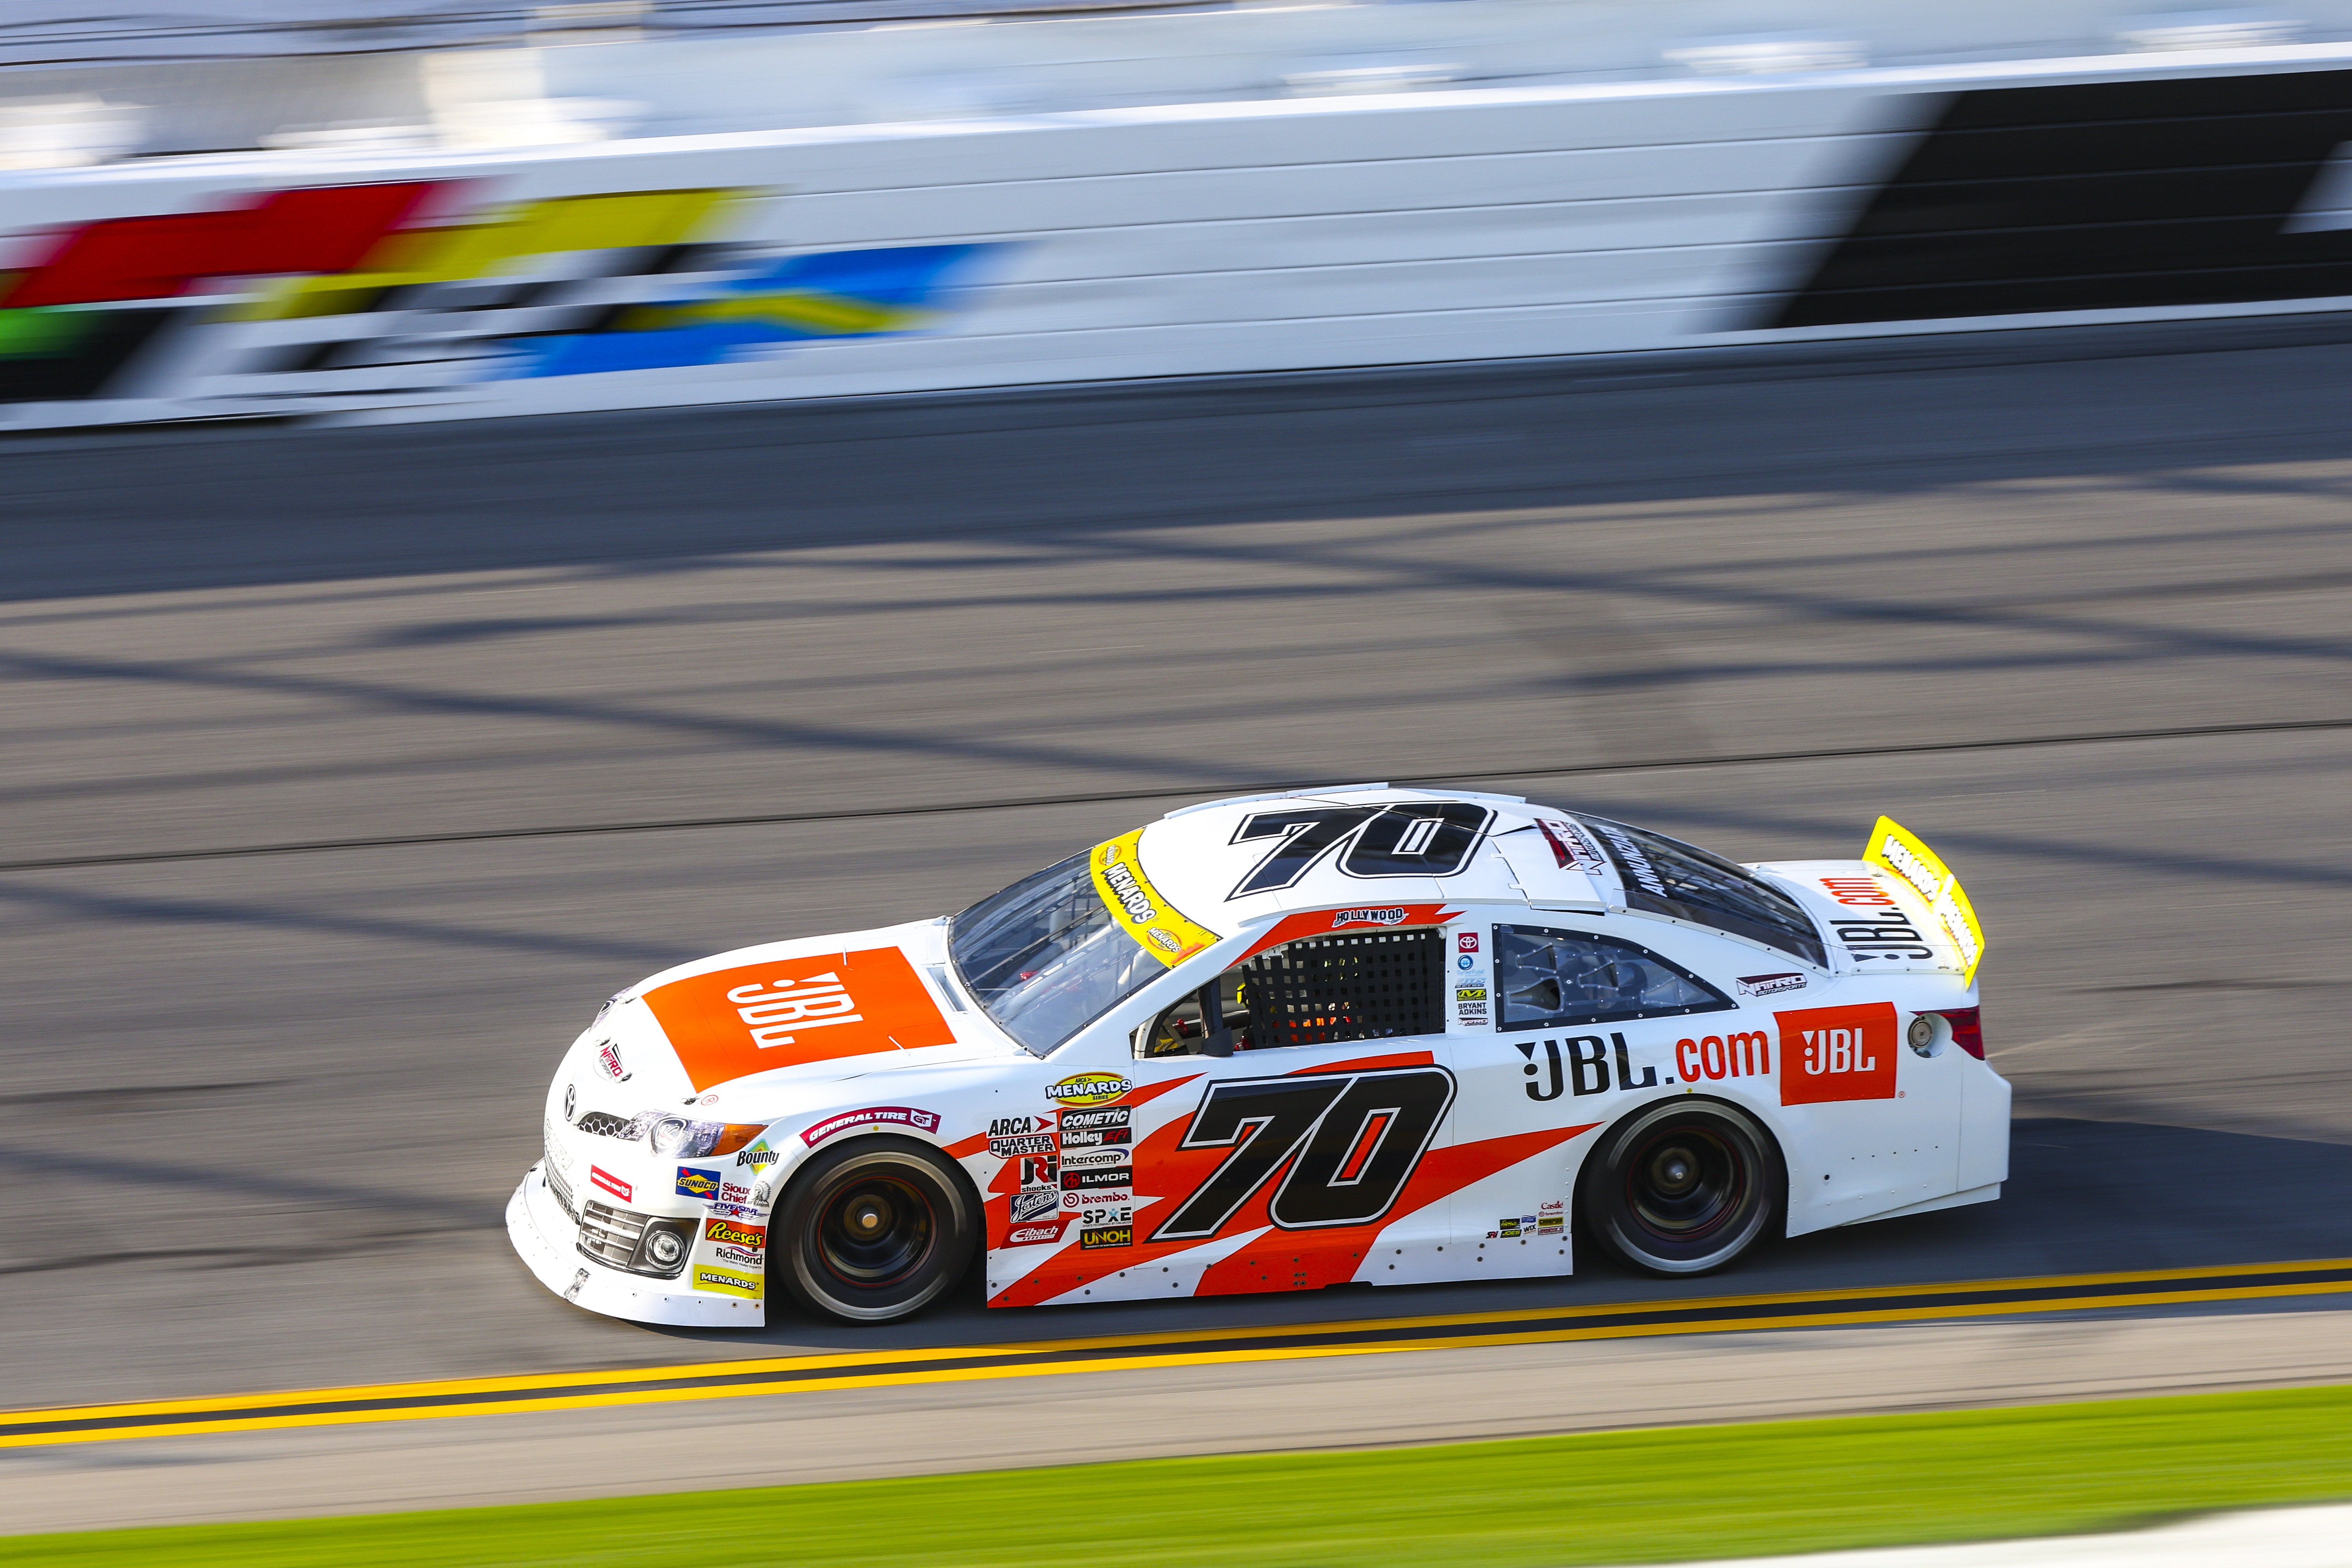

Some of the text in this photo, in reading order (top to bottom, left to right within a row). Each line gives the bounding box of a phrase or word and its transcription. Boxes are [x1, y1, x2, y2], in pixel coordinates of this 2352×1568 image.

[1223, 800, 1498, 902] 70
[1539, 819, 1607, 875] NITRO
[1595, 824, 1668, 897] ANNUNZIATA
[1881, 834, 1939, 902] MENARDS
[1100, 862, 1157, 924] MENARDS
[1337, 908, 1403, 922] HOLLYWOOD
[1147, 927, 1181, 952] MENARDS
[1736, 975, 1807, 997] NITRO
[1758, 983, 1806, 996] MOTORSPORTS
[727, 971, 864, 1049] JBL
[1802, 1028, 1876, 1075] JBL
[599, 1044, 623, 1077] NITRO
[599, 1058, 613, 1079] MOTORSPORTS
[1045, 1079, 1132, 1099] MENARDS
[809, 1113, 873, 1142] GENERAL
[874, 1112, 907, 1120] TIRE
[988, 1117, 1031, 1136] ARCA
[1062, 1111, 1128, 1127] COMETIC
[991, 1136, 1050, 1152] QUARTER
[1062, 1131, 1103, 1145] Holley
[1001, 1143, 1054, 1156] MASTER
[1143, 1063, 1458, 1243] 70
[737, 1150, 779, 1167] Bounty
[1062, 1154, 1121, 1165] Intercomp
[592, 1172, 611, 1187] GENERAL
[611, 1182, 621, 1192] TIRE
[679, 1178, 717, 1189] SUNOCO
[1082, 1173, 1129, 1183] ILMOR
[722, 1182, 751, 1195] Sioux
[721, 1192, 747, 1204] Chief
[1082, 1192, 1128, 1204] brembo
[1541, 1201, 1563, 1210] Castle
[738, 1207, 758, 1215] STAR
[1011, 1191, 1058, 1223] Jostens
[707, 1222, 763, 1245] Reese's
[1010, 1226, 1058, 1242] Eibach
[1523, 1224, 1536, 1232] WIX
[1085, 1230, 1130, 1244] UNOH
[716, 1247, 762, 1265] Richmond
[700, 1272, 756, 1289] MENARDS
